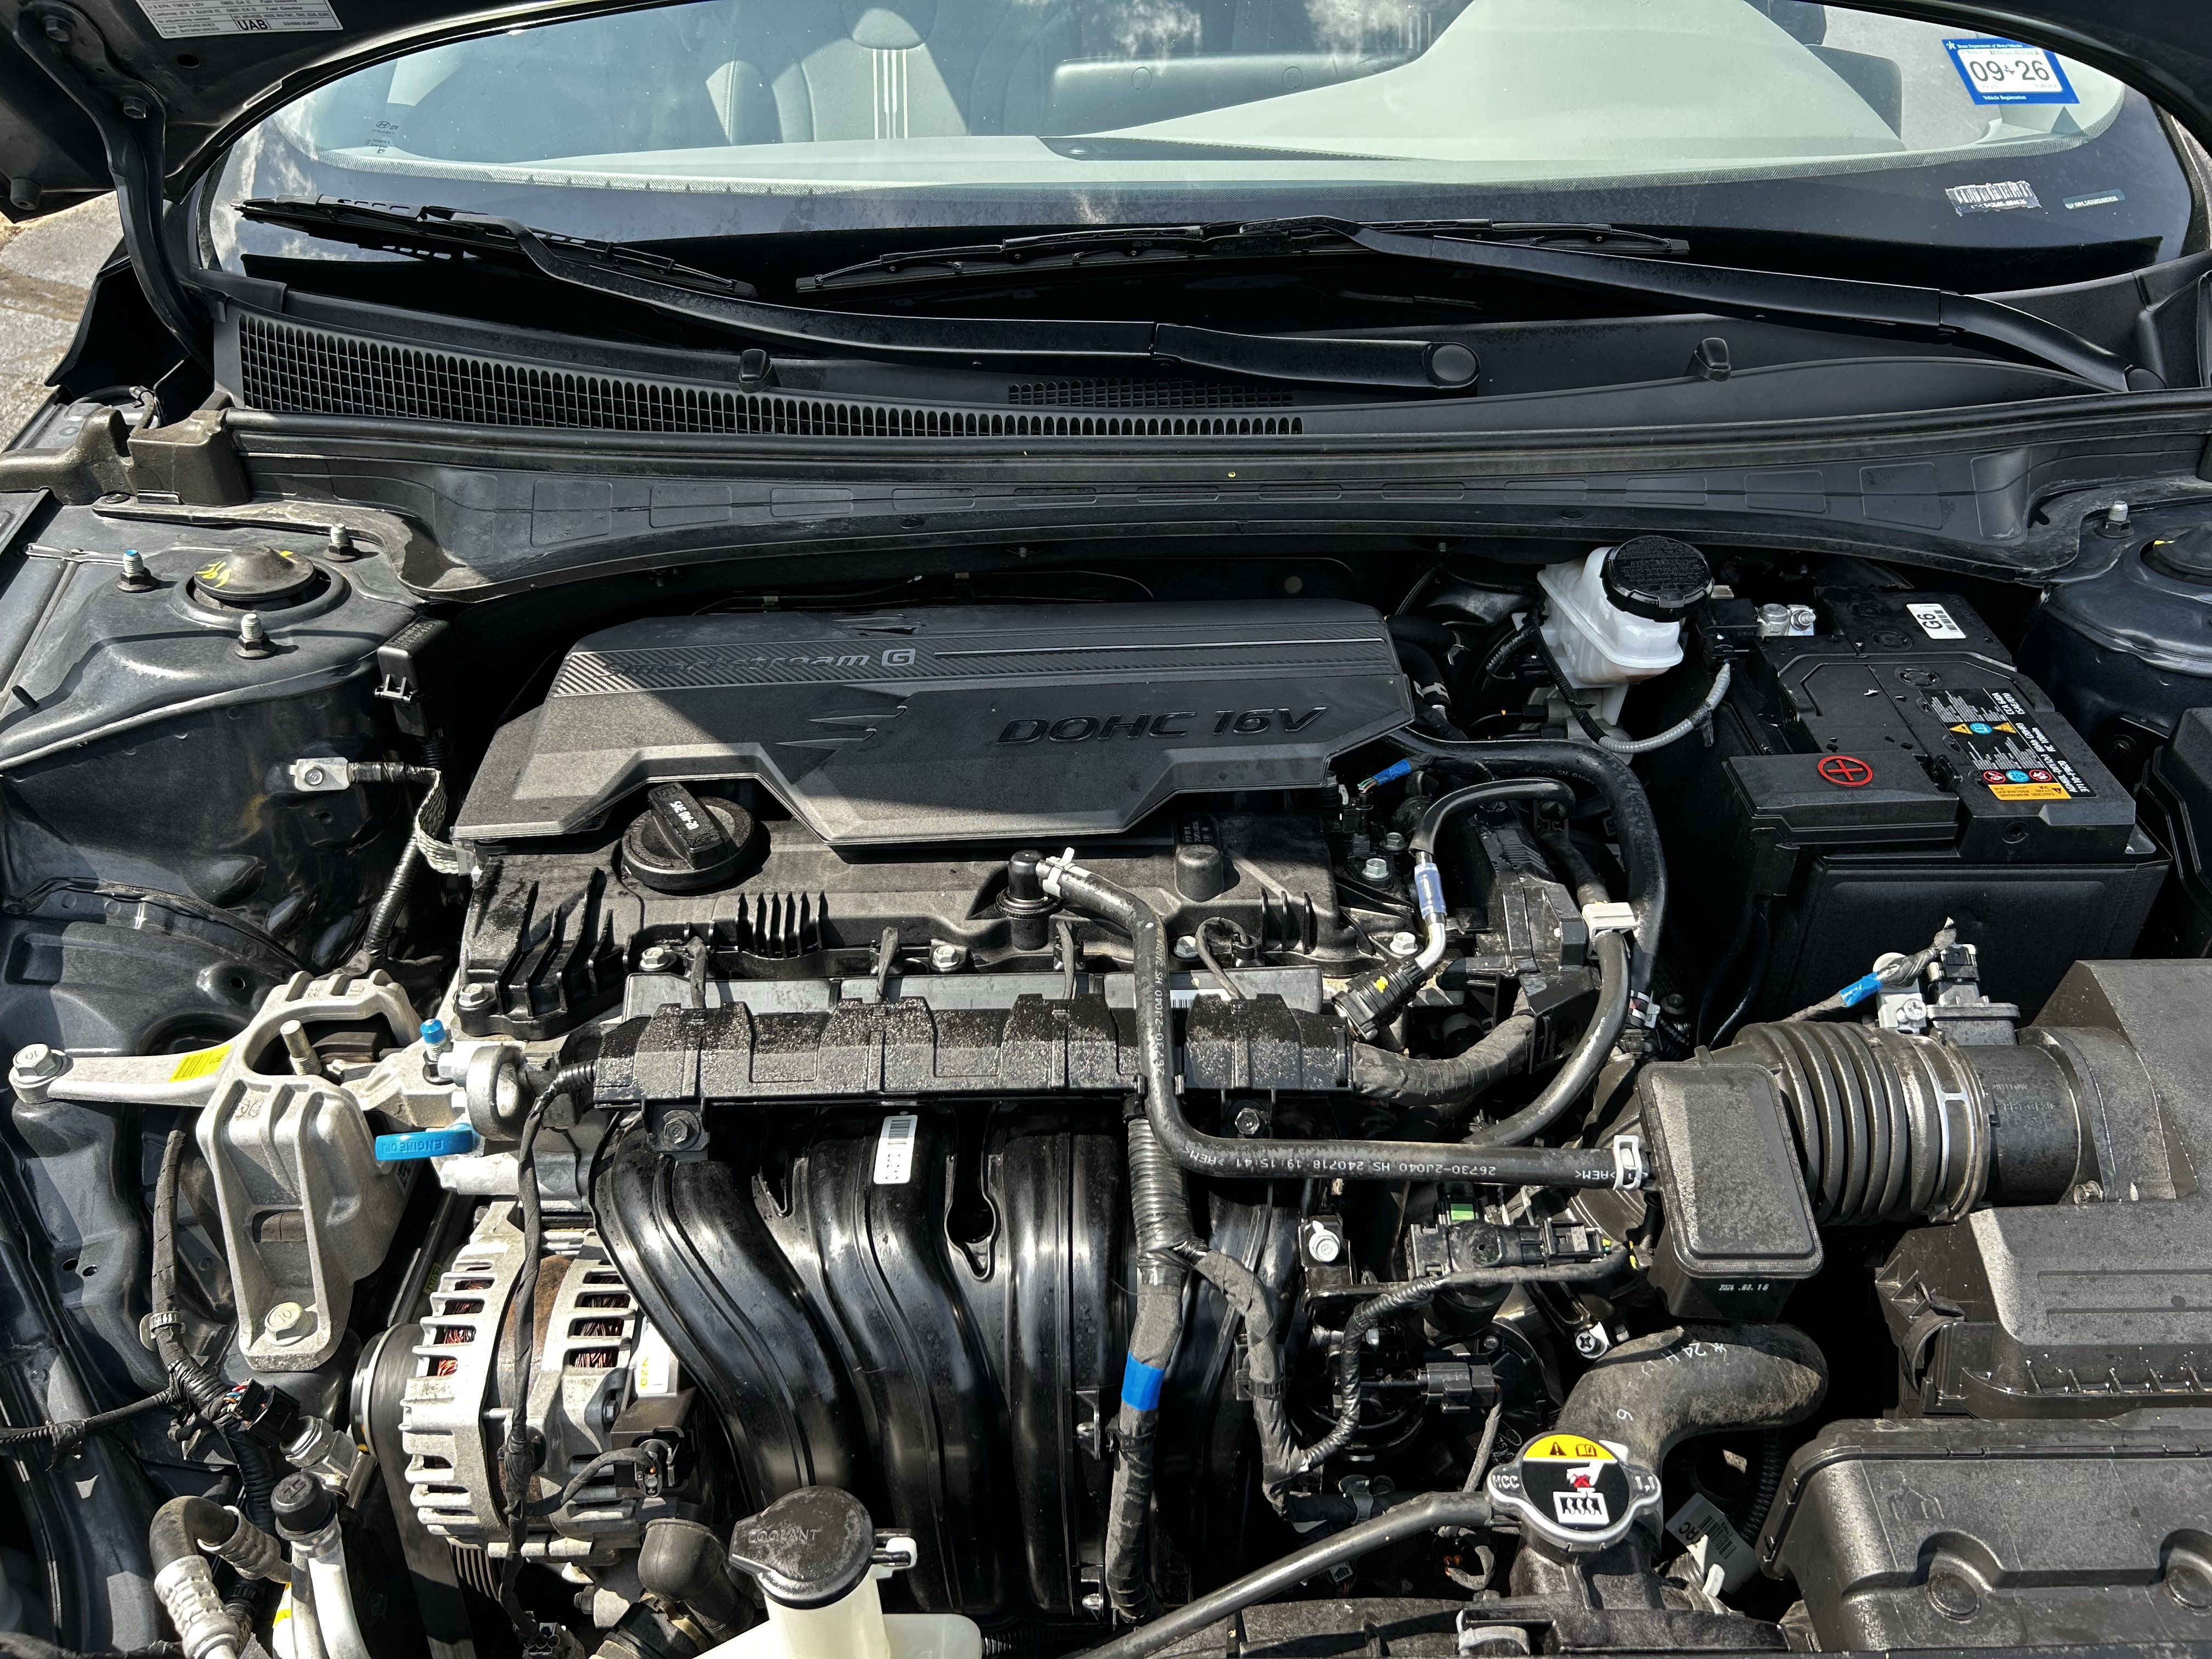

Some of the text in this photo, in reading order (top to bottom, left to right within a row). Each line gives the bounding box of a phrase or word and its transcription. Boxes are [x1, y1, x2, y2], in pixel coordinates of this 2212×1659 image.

[237, 20, 268, 30] UAB
[1970, 60, 2050, 82] 09 26
[1917, 613, 1942, 630] G6
[995, 706, 1328, 745] DOHC 16V
[670, 801, 699, 830] SAE 0W-20
[381, 1139, 443, 1154] ENGINE OIL
[1312, 1159, 1364, 1171] 240718
[1373, 1161, 1390, 1171] HS
[1399, 1162, 1497, 1176] 26730-2J040
[747, 1528, 822, 1545] COOLANT
